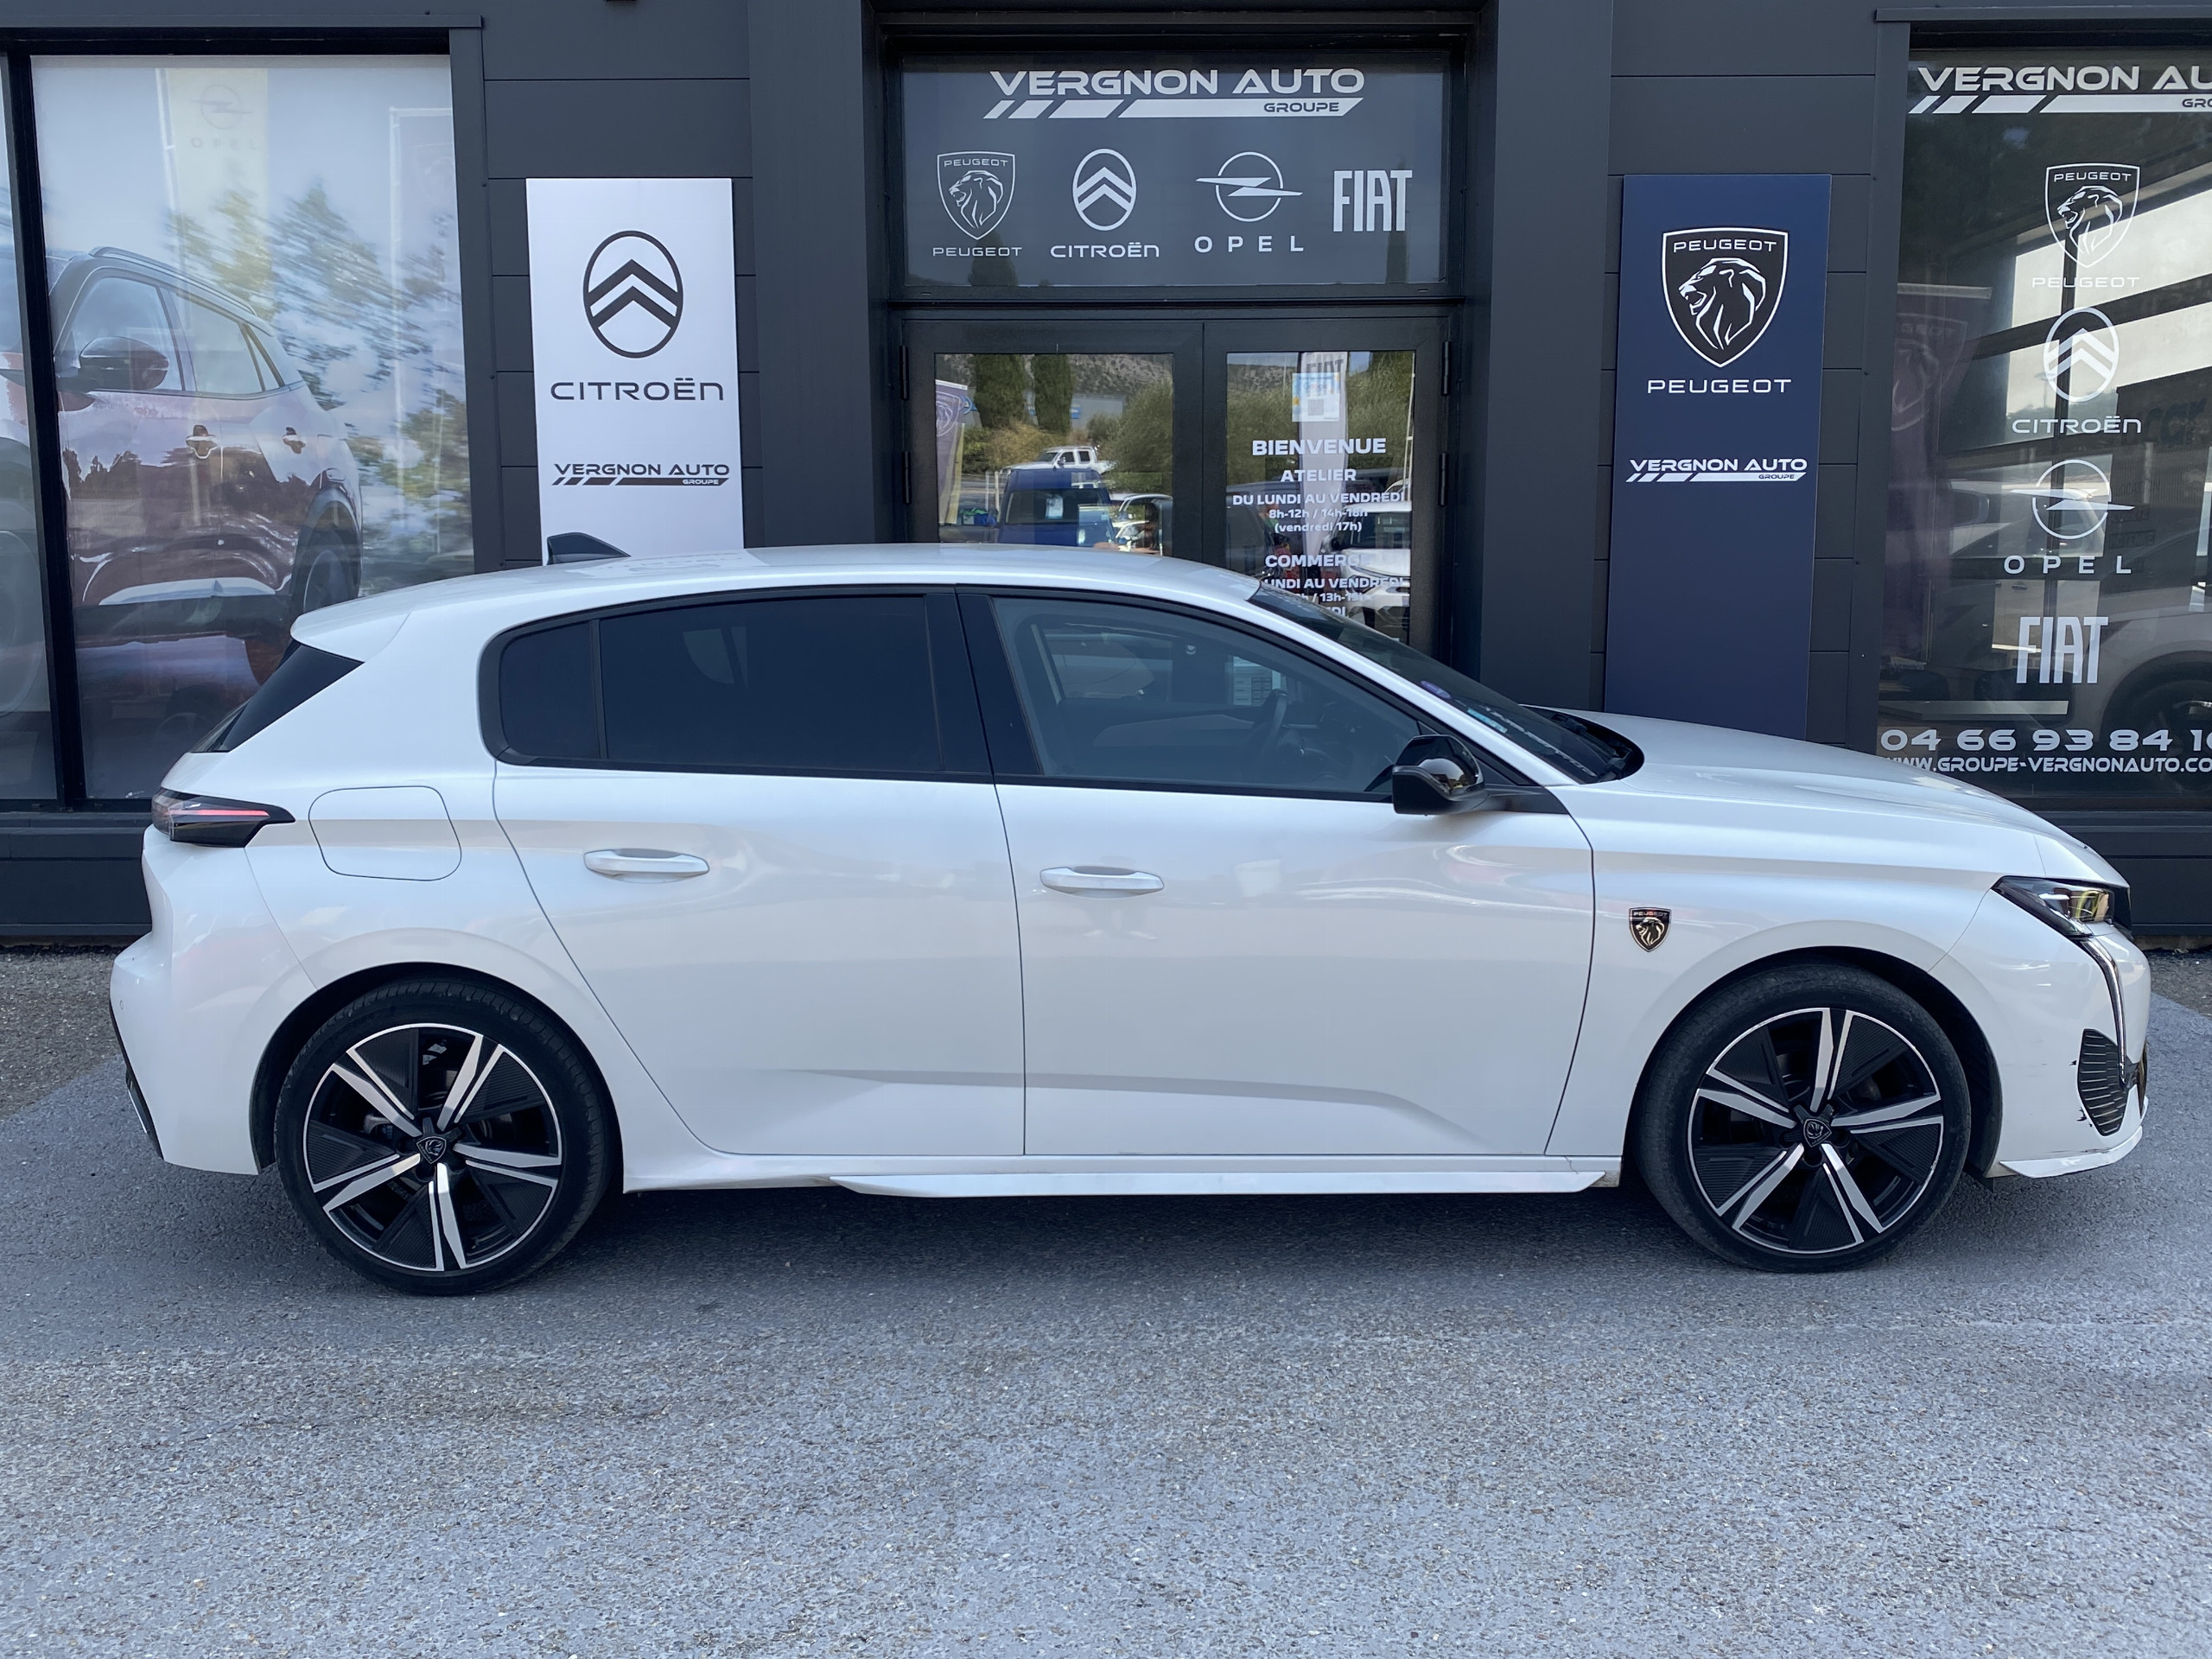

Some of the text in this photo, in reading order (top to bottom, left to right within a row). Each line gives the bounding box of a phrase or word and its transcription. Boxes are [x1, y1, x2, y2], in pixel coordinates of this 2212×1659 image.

[989, 68, 1365, 96] VERGNON AUTO
[1917, 66, 2139, 92] VERGNON
[1263, 101, 1339, 112] GROUPE
[944, 158, 1008, 168] PEUGEOT
[2053, 172, 2132, 182] PEUGEOT
[1332, 170, 1413, 232] FIAT
[1051, 242, 1160, 257] CITROËN
[1194, 235, 1304, 252] OPEL
[1674, 239, 1777, 253] PEUGEOT
[933, 246, 1023, 257] PEUGEOT
[2031, 276, 2140, 289] PEUGEOT
[550, 378, 724, 401] CITROËN
[1648, 378, 1792, 394] PEUGEOT
[1252, 438, 1387, 455] BIENVENUE
[554, 463, 730, 476] VERGNON AUTO
[1630, 458, 1808, 472] VERGNON AUTO
[1280, 468, 1357, 482] ATELIER
[1232, 493, 1404, 505] DU LUNDI AU VENDREDI
[1268, 509, 1310, 518] 8h-12h
[1274, 522, 1363, 533] (vendredi 17h)
[1265, 555, 1370, 567] COMMERCE
[2004, 556, 2133, 575] OPEL
[1303, 578, 1325, 588] AU
[1329, 577, 1403, 588] VENDREDI
[2016, 617, 2108, 683] FIAT
[1880, 729, 2212, 751] 04 66 93 84 1
[1885, 757, 2212, 772] WW.GROUPE-VERGNONAUTO.CO
